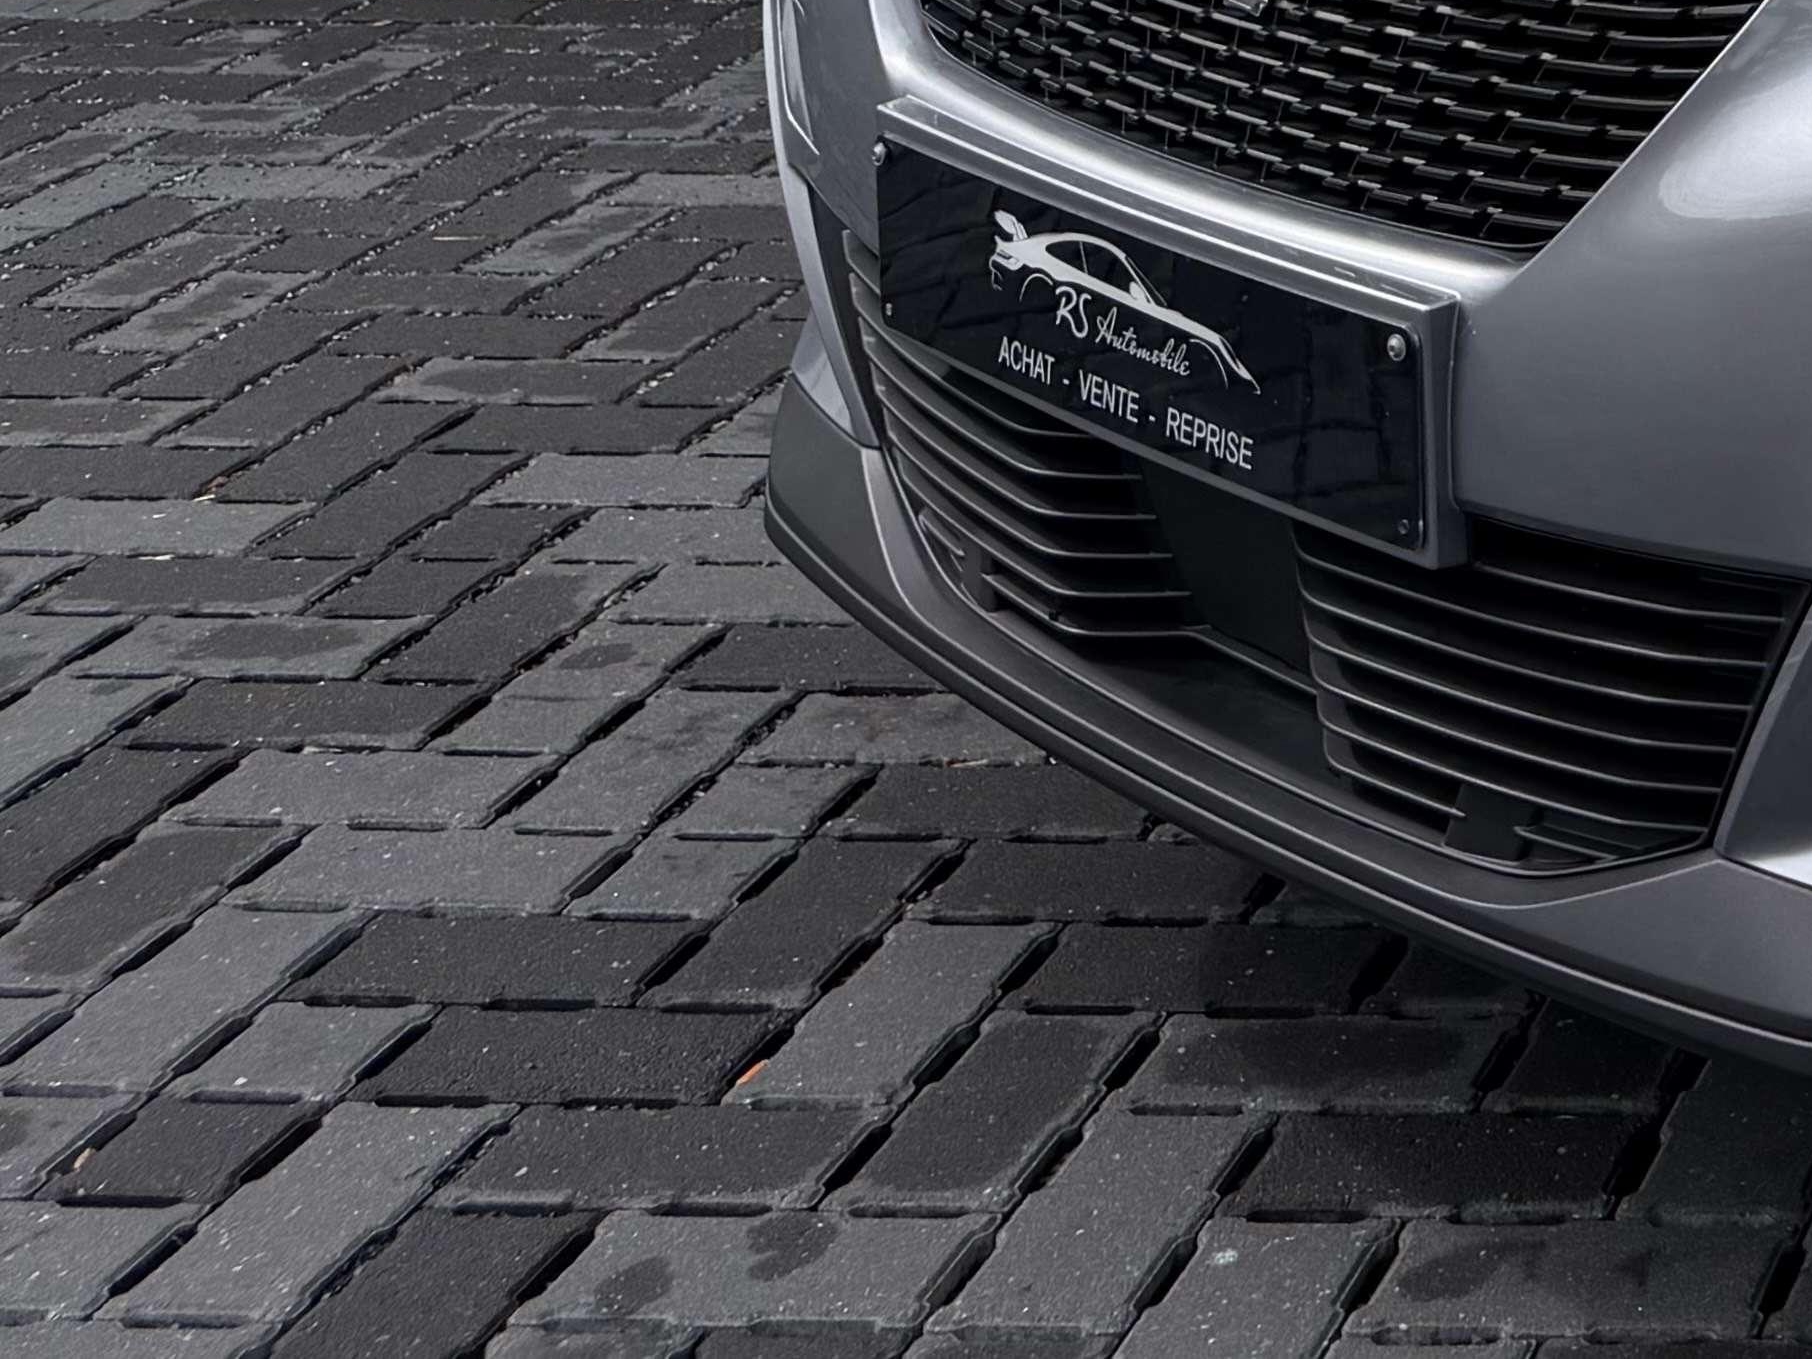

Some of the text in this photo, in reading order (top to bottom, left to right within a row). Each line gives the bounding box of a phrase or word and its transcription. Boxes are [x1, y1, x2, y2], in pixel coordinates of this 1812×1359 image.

[1055, 285, 1191, 376] RS Automobile
[998, 336, 1055, 385] ACHAT
[1079, 369, 1140, 423] VENTE
[1166, 407, 1254, 470] REPRISE
